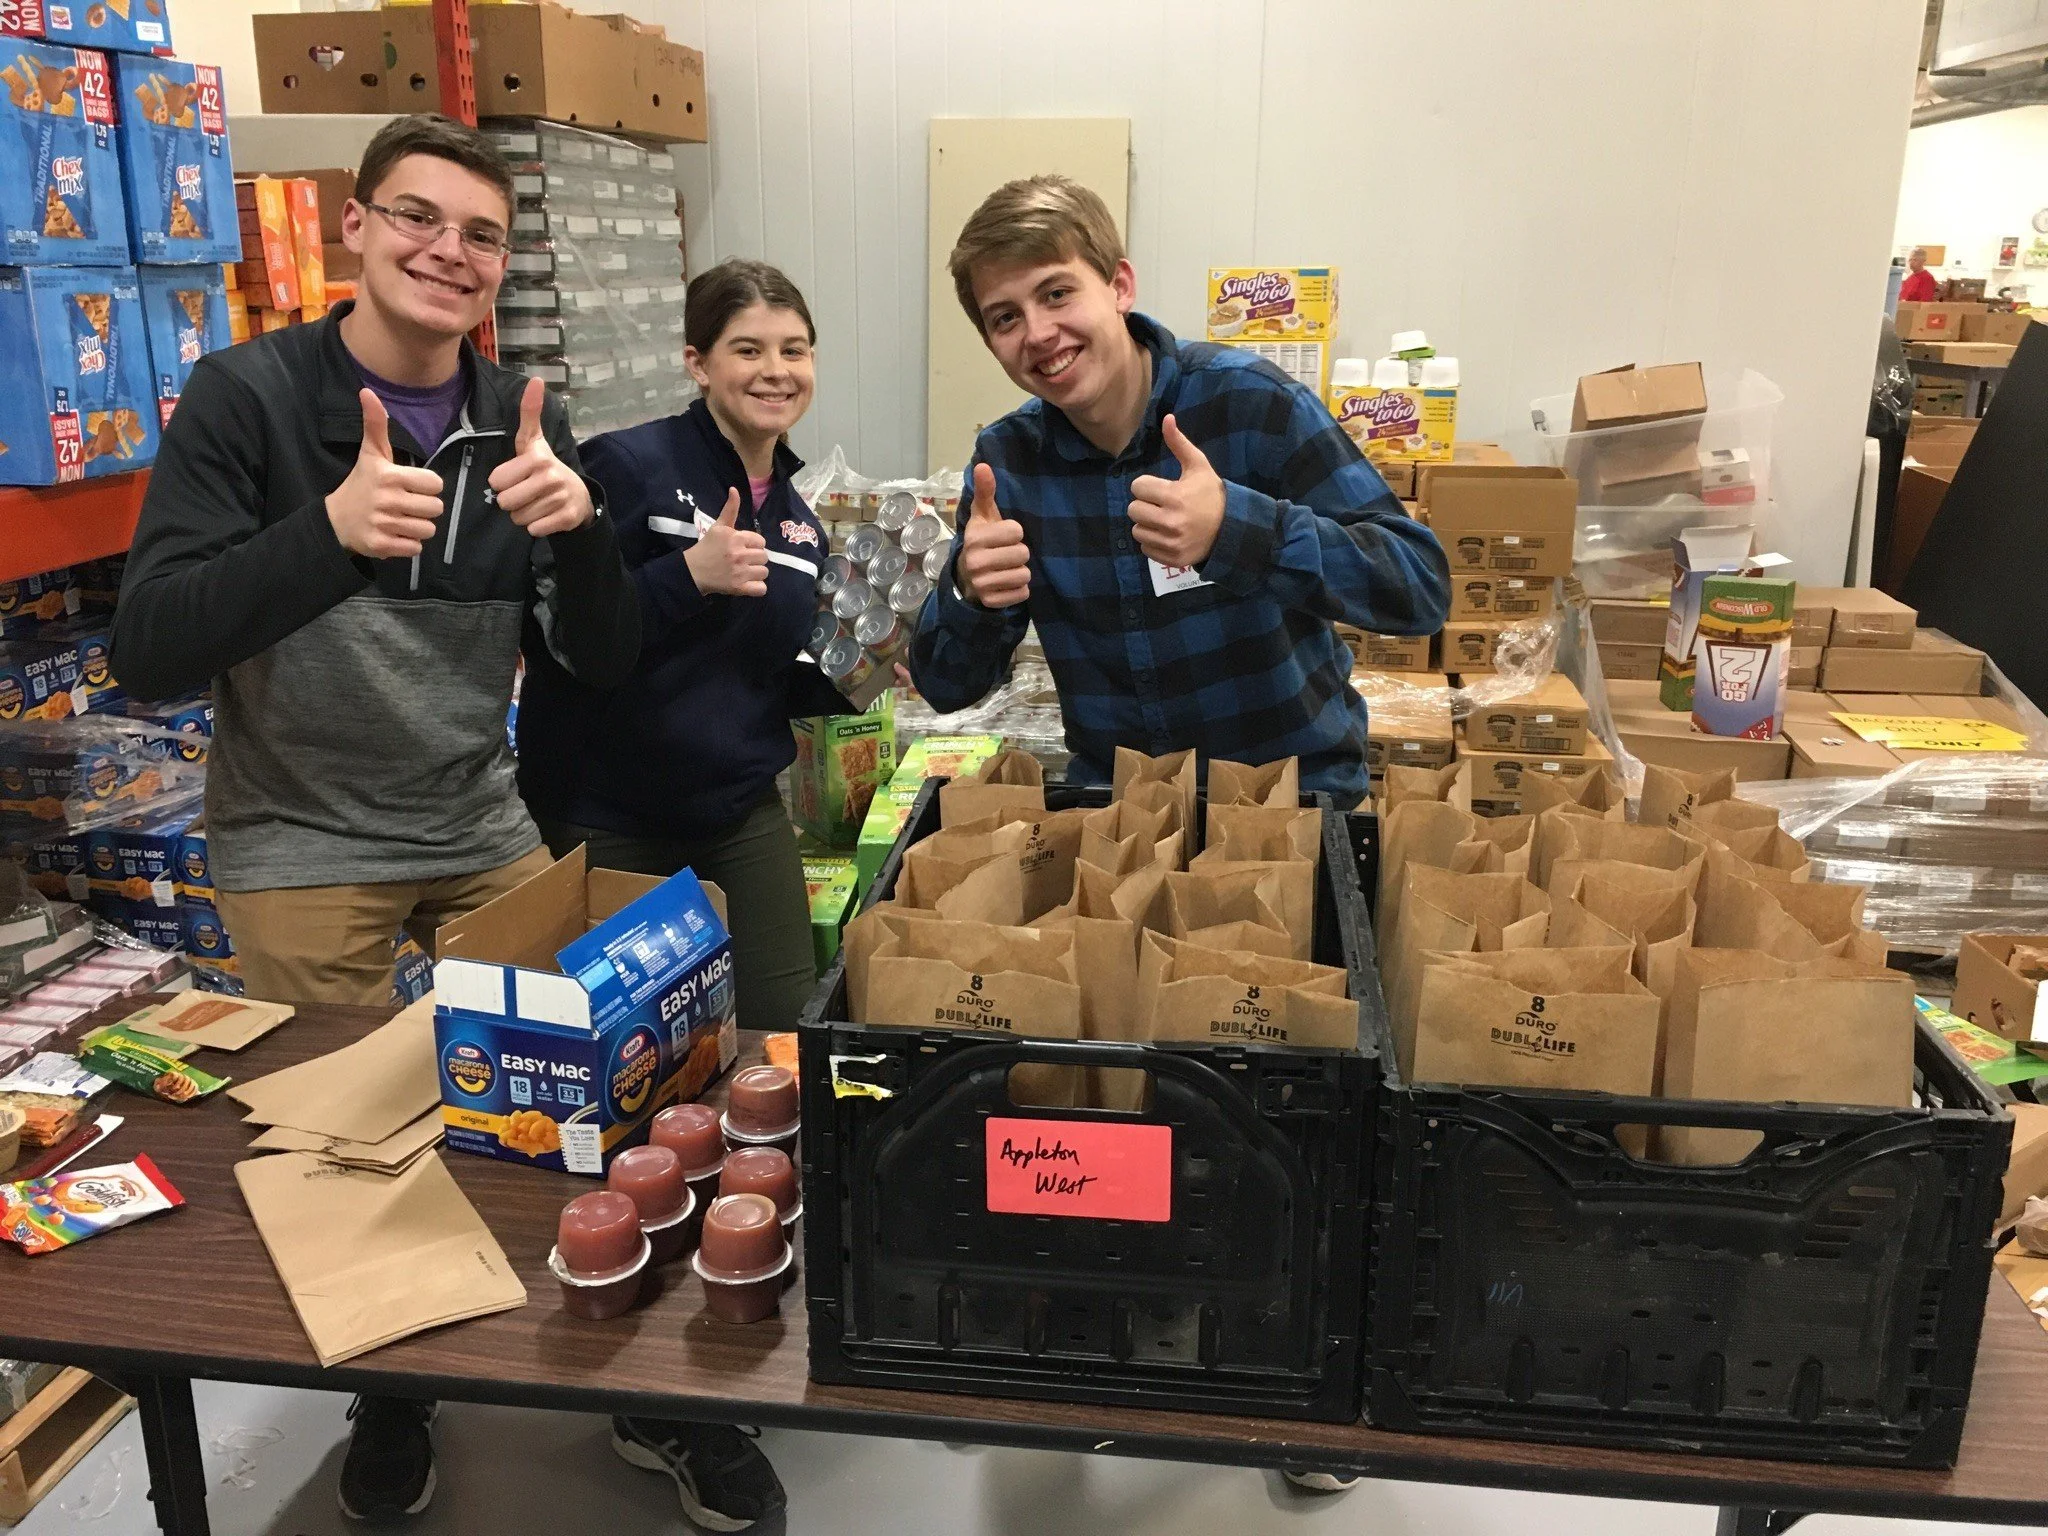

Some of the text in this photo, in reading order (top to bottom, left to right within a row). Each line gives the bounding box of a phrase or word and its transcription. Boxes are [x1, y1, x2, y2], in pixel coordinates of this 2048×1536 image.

[79, 51, 103, 70] NOW
[198, 67, 216, 86] NOW
[84, 72, 106, 98] 42
[202, 88, 219, 111] 42
[86, 105, 110, 119] BAGS!
[34, 124, 51, 204] TRADITIONAL
[53, 157, 82, 178] Chex
[162, 136, 176, 208] TRADITIONAL
[176, 165, 200, 184] Chex
[1219, 272, 1279, 301] Singles
[1254, 288, 1269, 302] to
[79, 351, 106, 375] Chex
[106, 325, 118, 402] TRADITIONAL
[1340, 391, 1402, 420] Singles
[1377, 410, 1391, 423] to
[59, 439, 79, 463] 42
[60, 464, 80, 481] NOW
[1754, 605, 1768, 613] OLD
[1720, 648, 1756, 684] 2
[1722, 682, 1748, 691] FOR
[1721, 690, 1748, 702] GO
[839, 728, 853, 736] Oats
[861, 724, 880, 733] Honey
[1033, 824, 1040, 835] 8
[1026, 839, 1045, 850] DURO
[971, 975, 983, 991] 8
[1247, 985, 1260, 999] 8
[957, 995, 994, 1008] DURO
[1531, 996, 1545, 1012] 8
[1232, 1005, 1270, 1017] DURO
[983, 1015, 1012, 1029] LIFE
[1515, 1016, 1556, 1031] DURO
[673, 1021, 686, 1041] 18
[1258, 1024, 1288, 1040] LIFE
[461, 1049, 476, 1057] Kraft
[625, 1037, 641, 1056] Kraft
[1544, 1038, 1576, 1053] LIFE
[448, 1057, 485, 1069] macaroni
[613, 1050, 651, 1083] macaroni
[513, 1080, 528, 1094] 18
[563, 1090, 575, 1099] 3.5
[460, 1114, 489, 1126] original
[1000, 1137, 1080, 1169] Appleton
[1036, 1172, 1098, 1196] West
[76, 1181, 130, 1208] Goldfish
